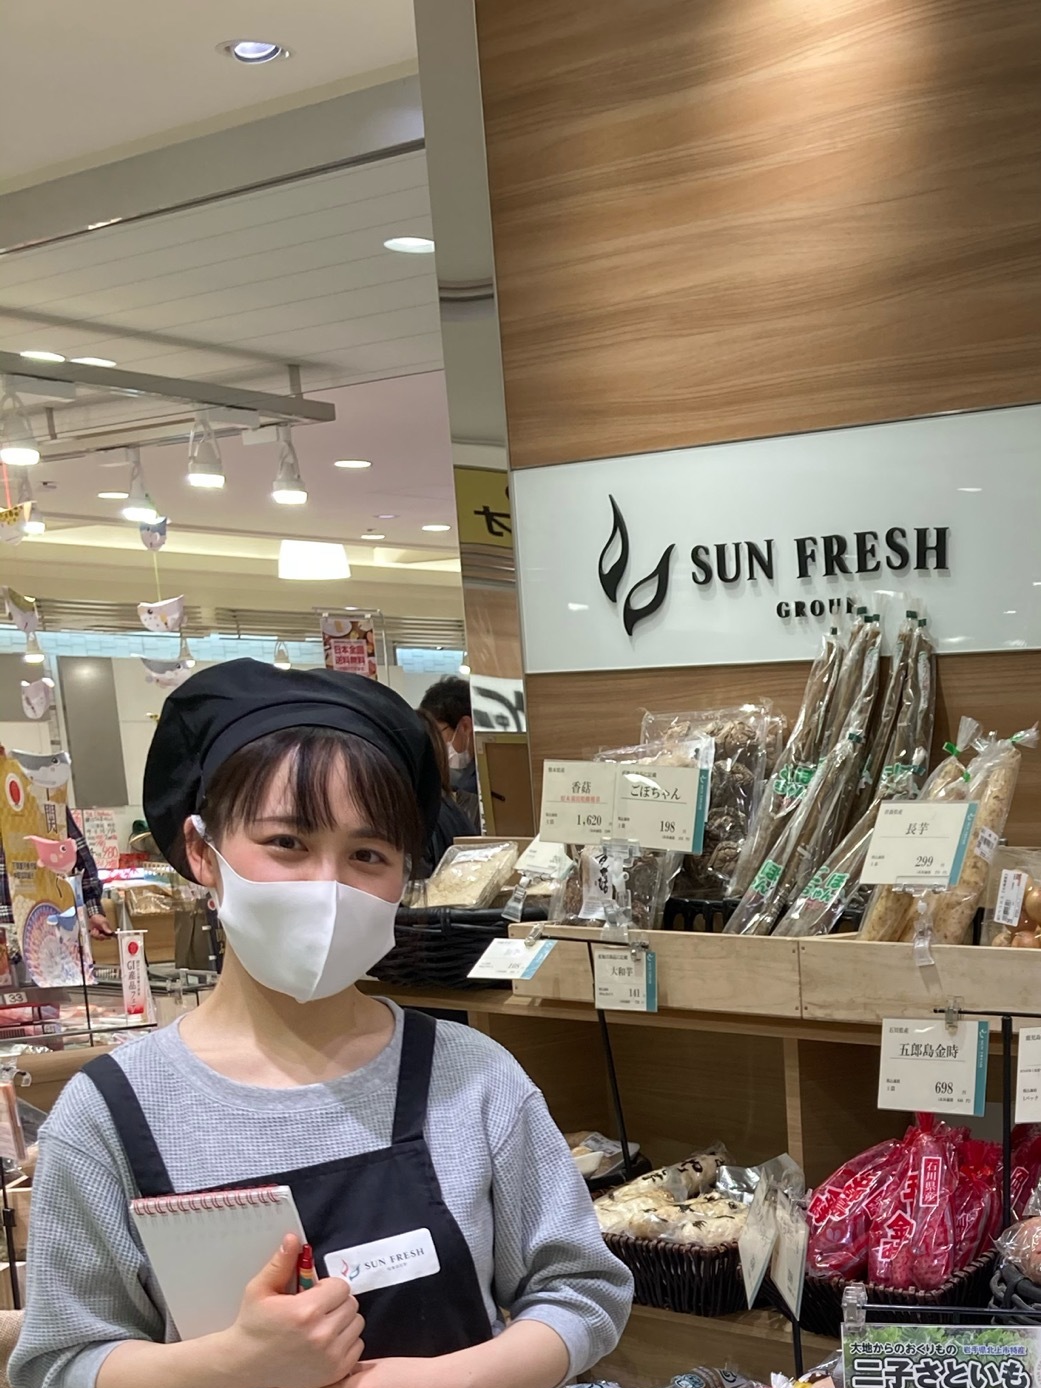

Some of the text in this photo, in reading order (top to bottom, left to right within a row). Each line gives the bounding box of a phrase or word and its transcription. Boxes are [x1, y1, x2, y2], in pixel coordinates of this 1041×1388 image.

[691, 527, 949, 585] SUN FRESH
[577, 814, 602, 827] 1,620
[660, 820, 676, 834] 198
[914, 855, 935, 868] 299
[899, 1042, 959, 1059] 五郎島金時
[935, 1081, 954, 1095] 698
[364, 1247, 425, 1271] SUN FRESH
[850, 1342, 957, 1356] 大地からのおくりもの
